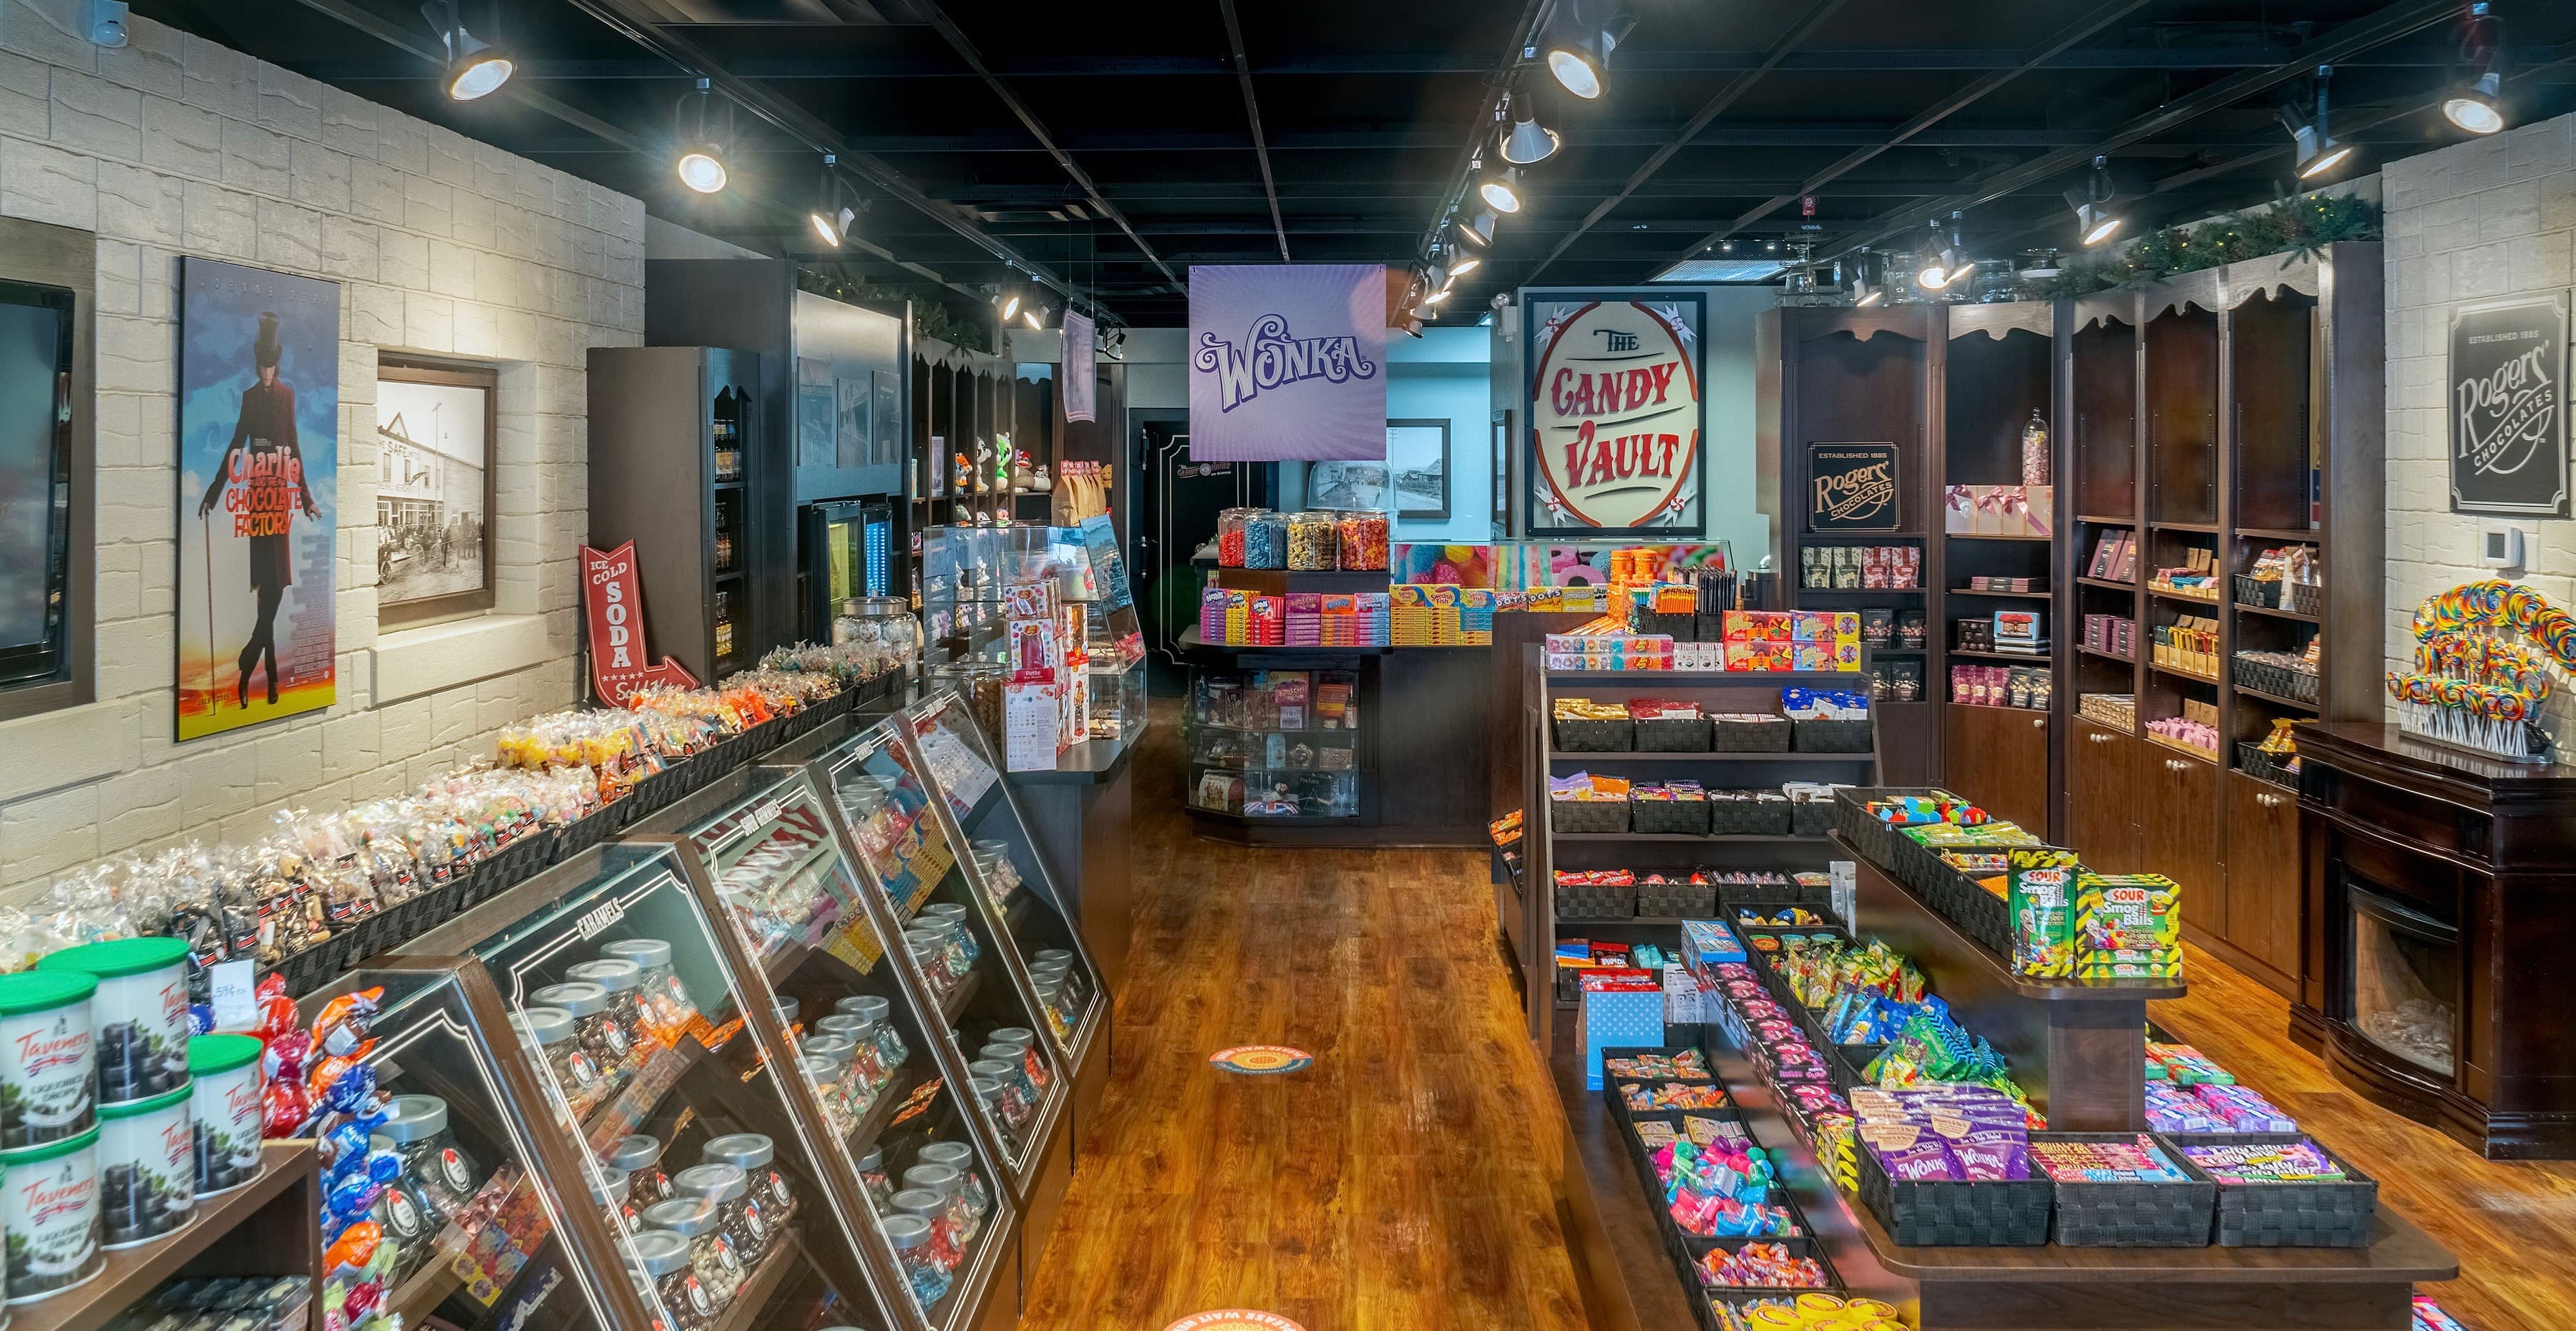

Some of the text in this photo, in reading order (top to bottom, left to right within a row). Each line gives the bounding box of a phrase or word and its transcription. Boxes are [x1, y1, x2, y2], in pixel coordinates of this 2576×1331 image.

[1593, 329, 1639, 352] THE
[2469, 329, 2540, 344] ESTABLISHED 1885
[1194, 313, 1376, 414] WONKA
[1551, 361, 1679, 416] CANDY
[2474, 389, 2552, 467] CHOCOLATES
[228, 445, 301, 484] Charlie
[1565, 420, 1679, 489] VAULT
[1814, 460, 1892, 513] Rogers'
[225, 487, 302, 512] CHOCOLATE
[1830, 482, 1893, 517] CHOCOLATES
[234, 511, 294, 537] FACTORY
[590, 560, 608, 570] ICE
[592, 562, 628, 585] COLD
[1495, 593, 1528, 607] DOTS
[1529, 589, 1561, 603] DOTS
[606, 581, 632, 668] SODA
[2029, 871, 2062, 882] SOUR
[2019, 882, 2058, 899] Smog
[2112, 889, 2145, 901] SOUR
[577, 897, 625, 941] CARAMELS
[2103, 902, 2140, 917] Smog
[2123, 913, 2154, 925] Balls
[15, 1028, 91, 1063] Taveners
[1953, 1148, 2004, 1169] WONKA
[21, 1174, 96, 1213] Taveners
[1198, 1312, 1240, 1323] WAIT
